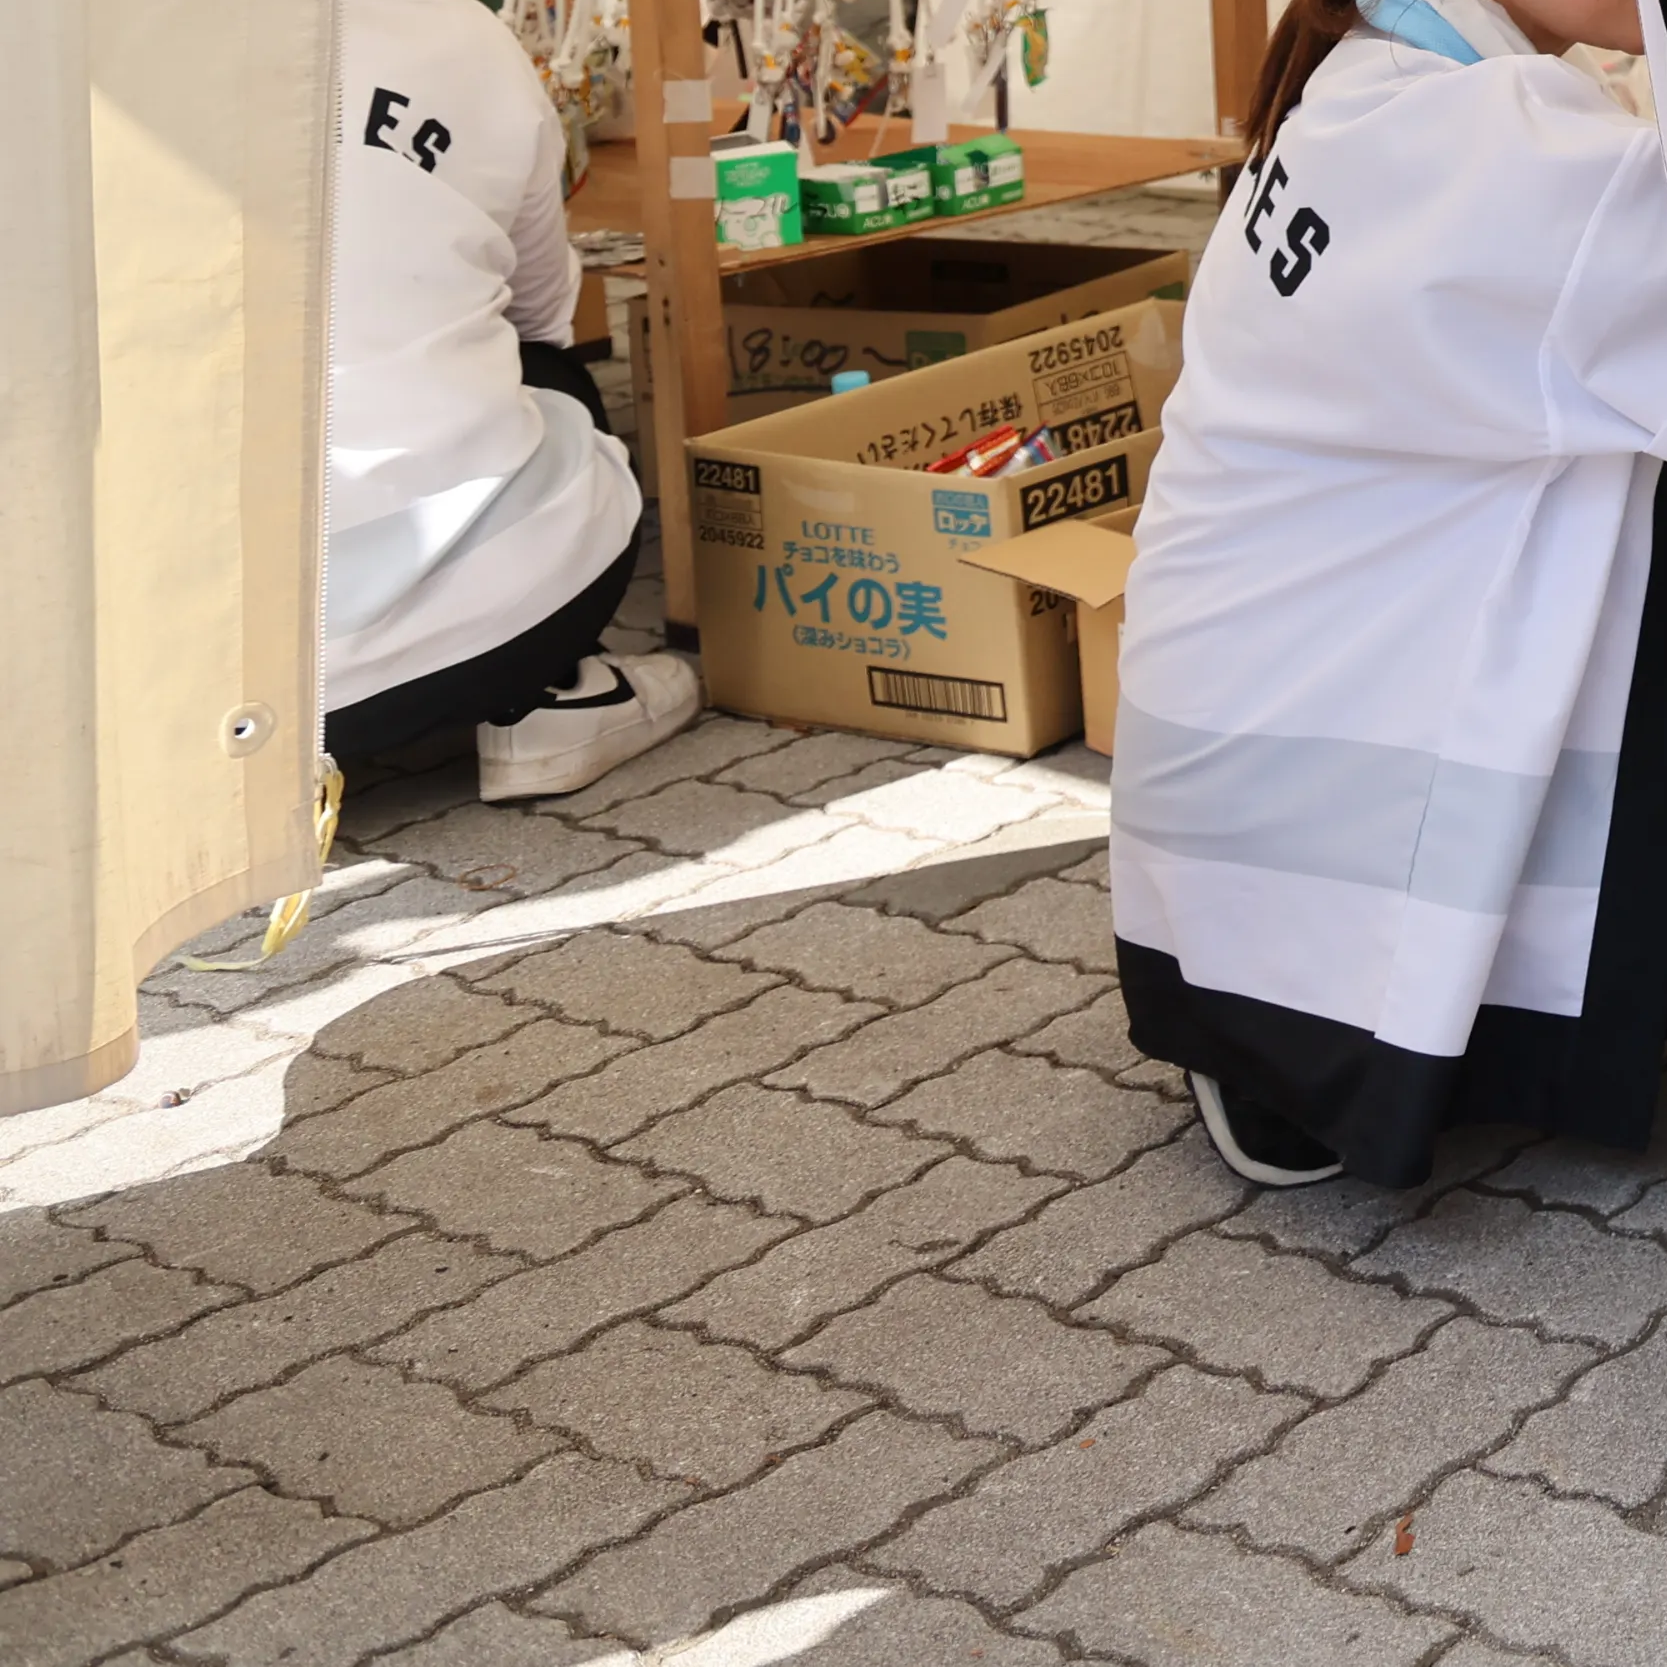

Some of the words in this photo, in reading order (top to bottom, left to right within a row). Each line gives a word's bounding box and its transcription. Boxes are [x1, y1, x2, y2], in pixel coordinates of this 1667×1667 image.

[1244, 152, 1330, 297] ES
[1028, 325, 1125, 374] 2045922
[856, 392, 1023, 466] 保存してください
[698, 463, 757, 491] 22481
[1027, 461, 1121, 524] 22481
[699, 525, 765, 550] 2045922
[802, 520, 876, 545] LOTTE
[938, 510, 989, 533] ロッテ
[783, 540, 901, 574] チョコを味わう
[753, 563, 947, 641] パイの実
